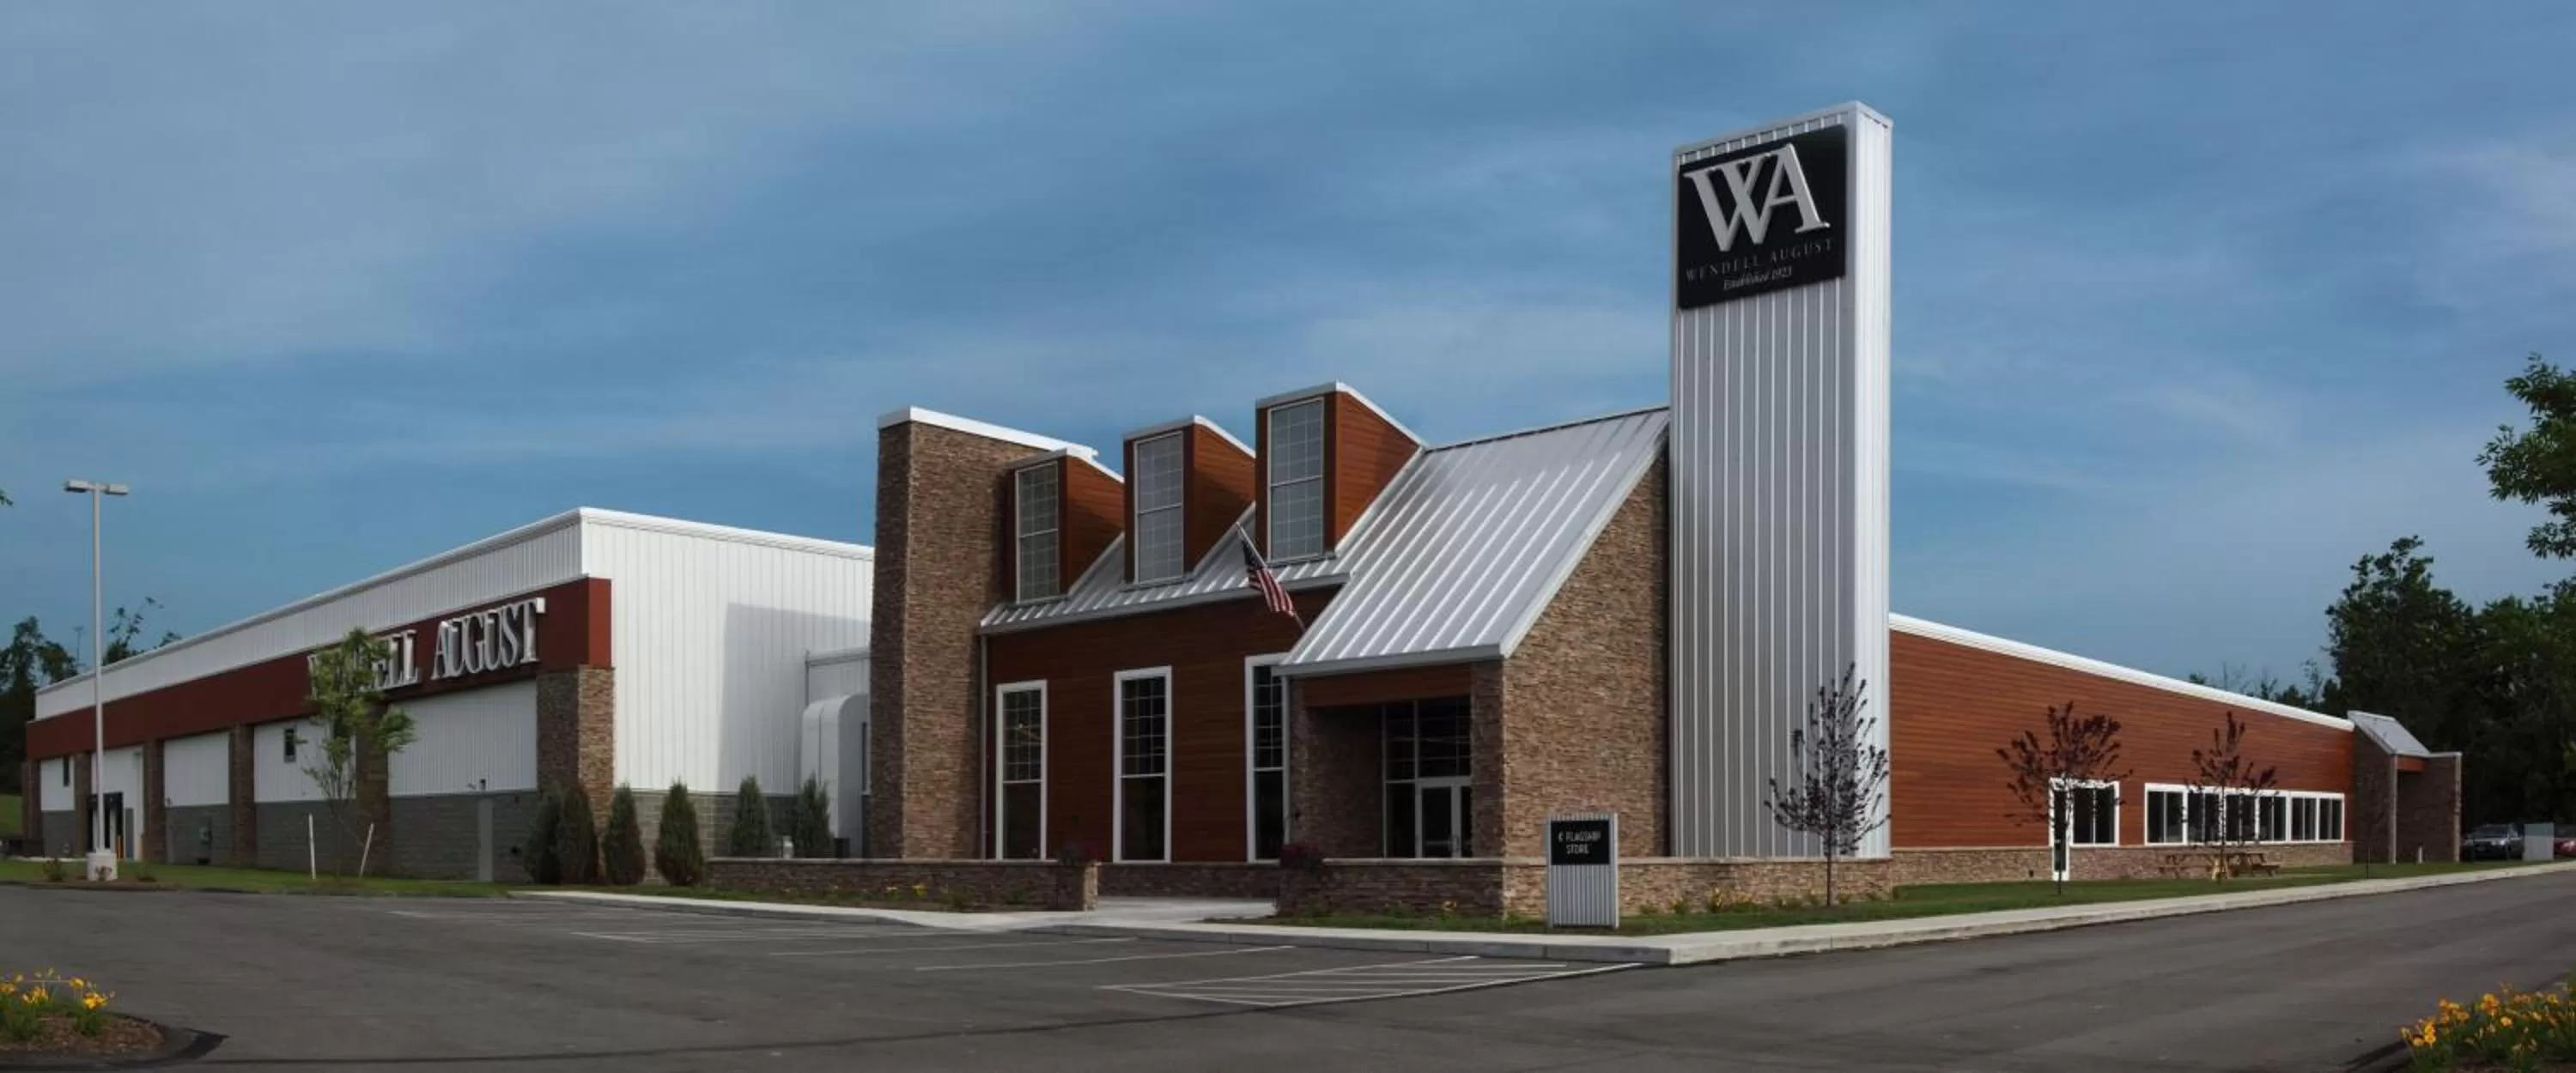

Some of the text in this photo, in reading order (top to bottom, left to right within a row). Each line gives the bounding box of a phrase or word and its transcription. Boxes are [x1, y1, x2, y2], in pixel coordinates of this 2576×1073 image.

[1683, 142, 1831, 252] WA
[1686, 237, 1834, 282] WENDELL AUGUST
[431, 597, 546, 681] AUGUST
